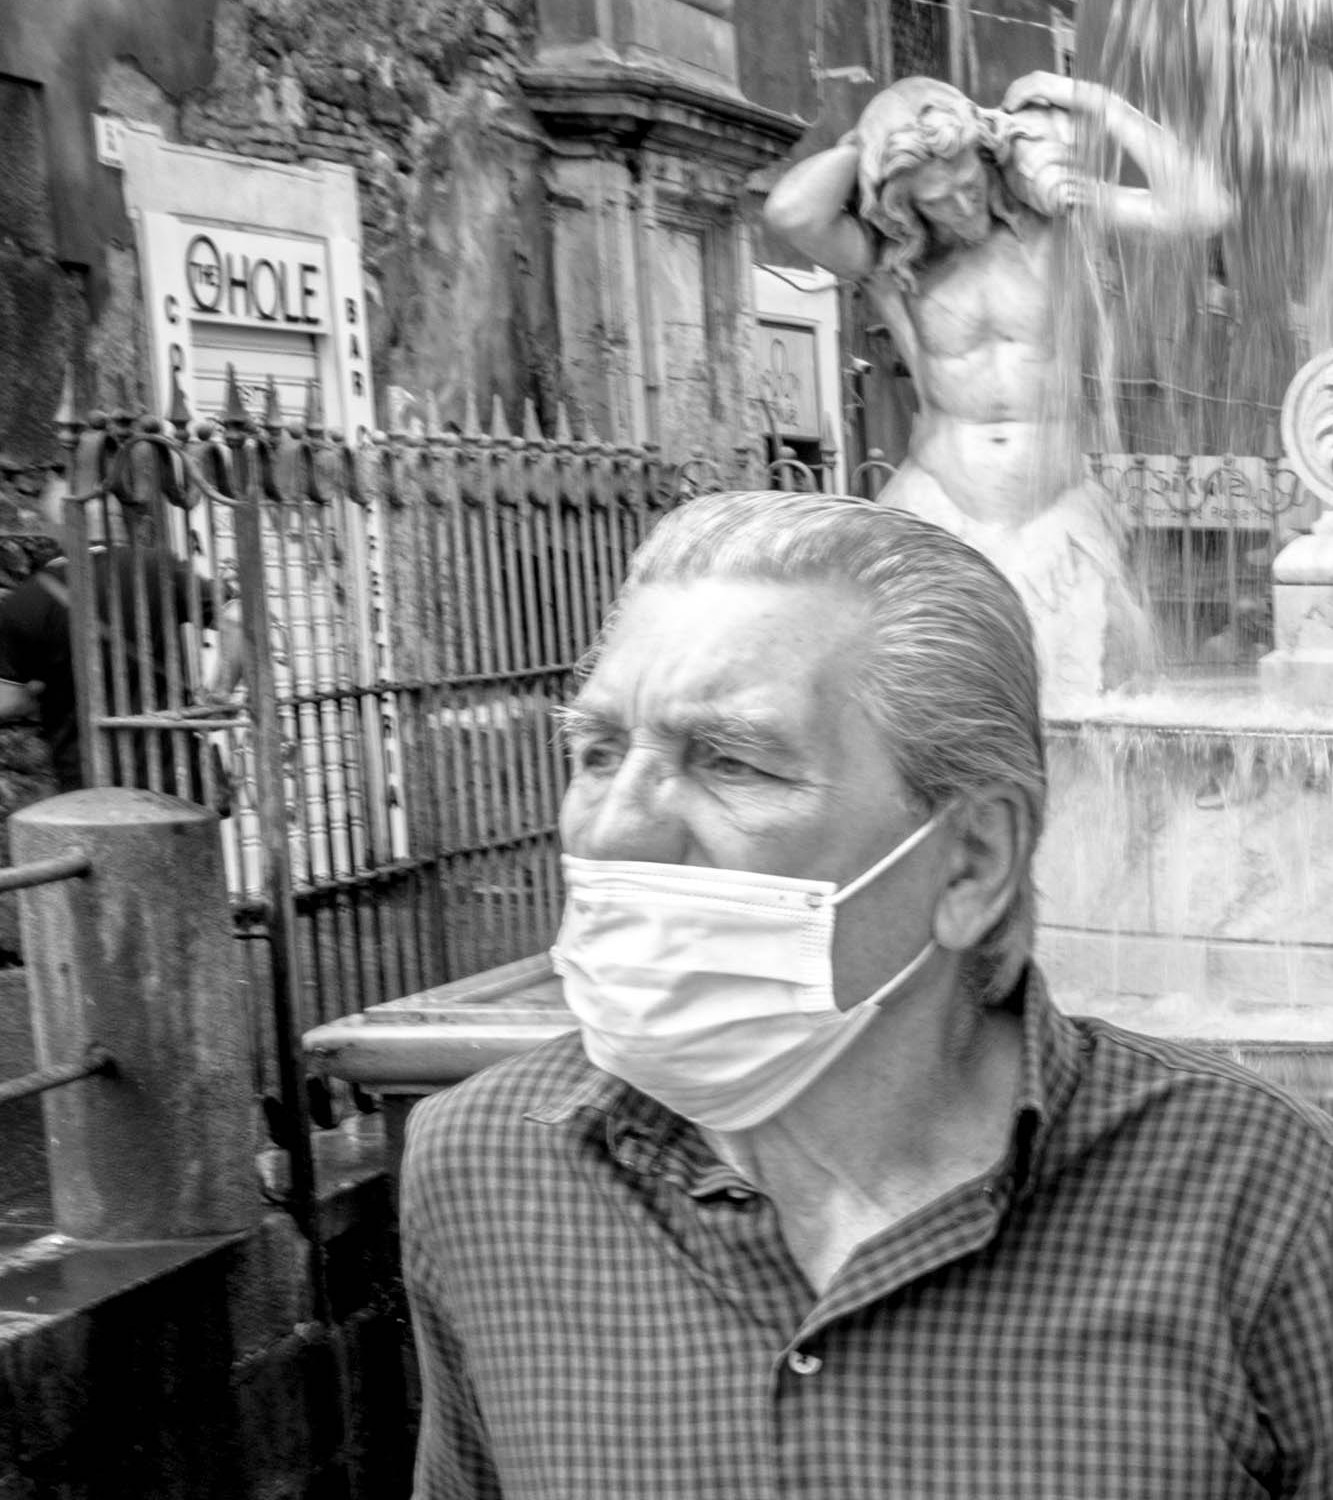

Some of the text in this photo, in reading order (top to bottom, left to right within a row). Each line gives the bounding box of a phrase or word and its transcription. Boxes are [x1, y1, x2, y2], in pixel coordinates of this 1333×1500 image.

[189, 251, 321, 326] THE HOLE
[345, 297, 364, 397] BAR
